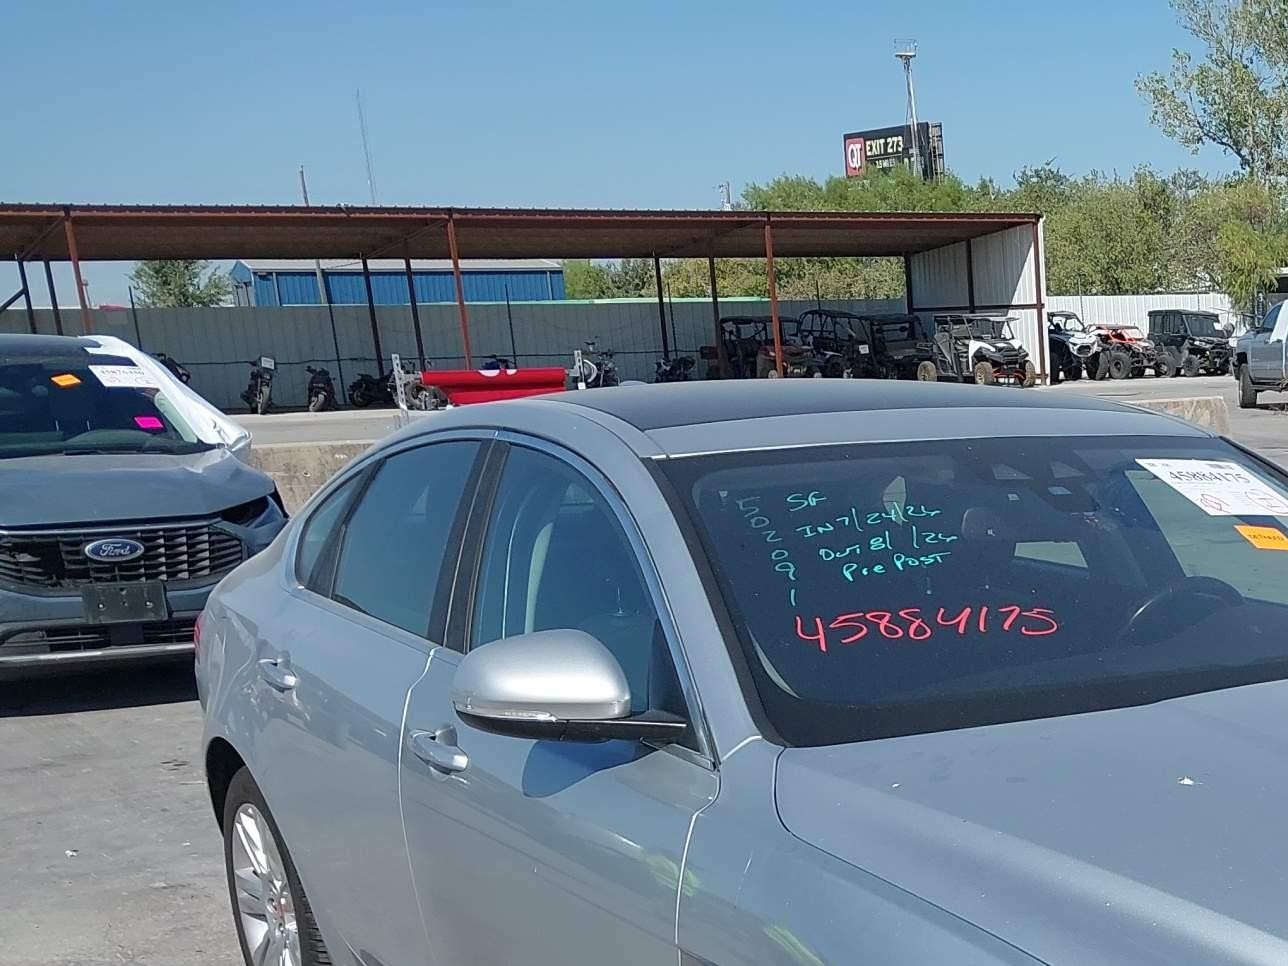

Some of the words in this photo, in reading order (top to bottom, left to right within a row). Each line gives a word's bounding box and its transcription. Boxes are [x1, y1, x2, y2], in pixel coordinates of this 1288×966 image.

[849, 143, 862, 169] QT
[865, 139, 885, 156] EXIT
[887, 135, 903, 153] 273
[1168, 471, 1251, 484] 45884175
[99, 543, 131, 556] Ford
[794, 605, 1059, 653] 45884175
